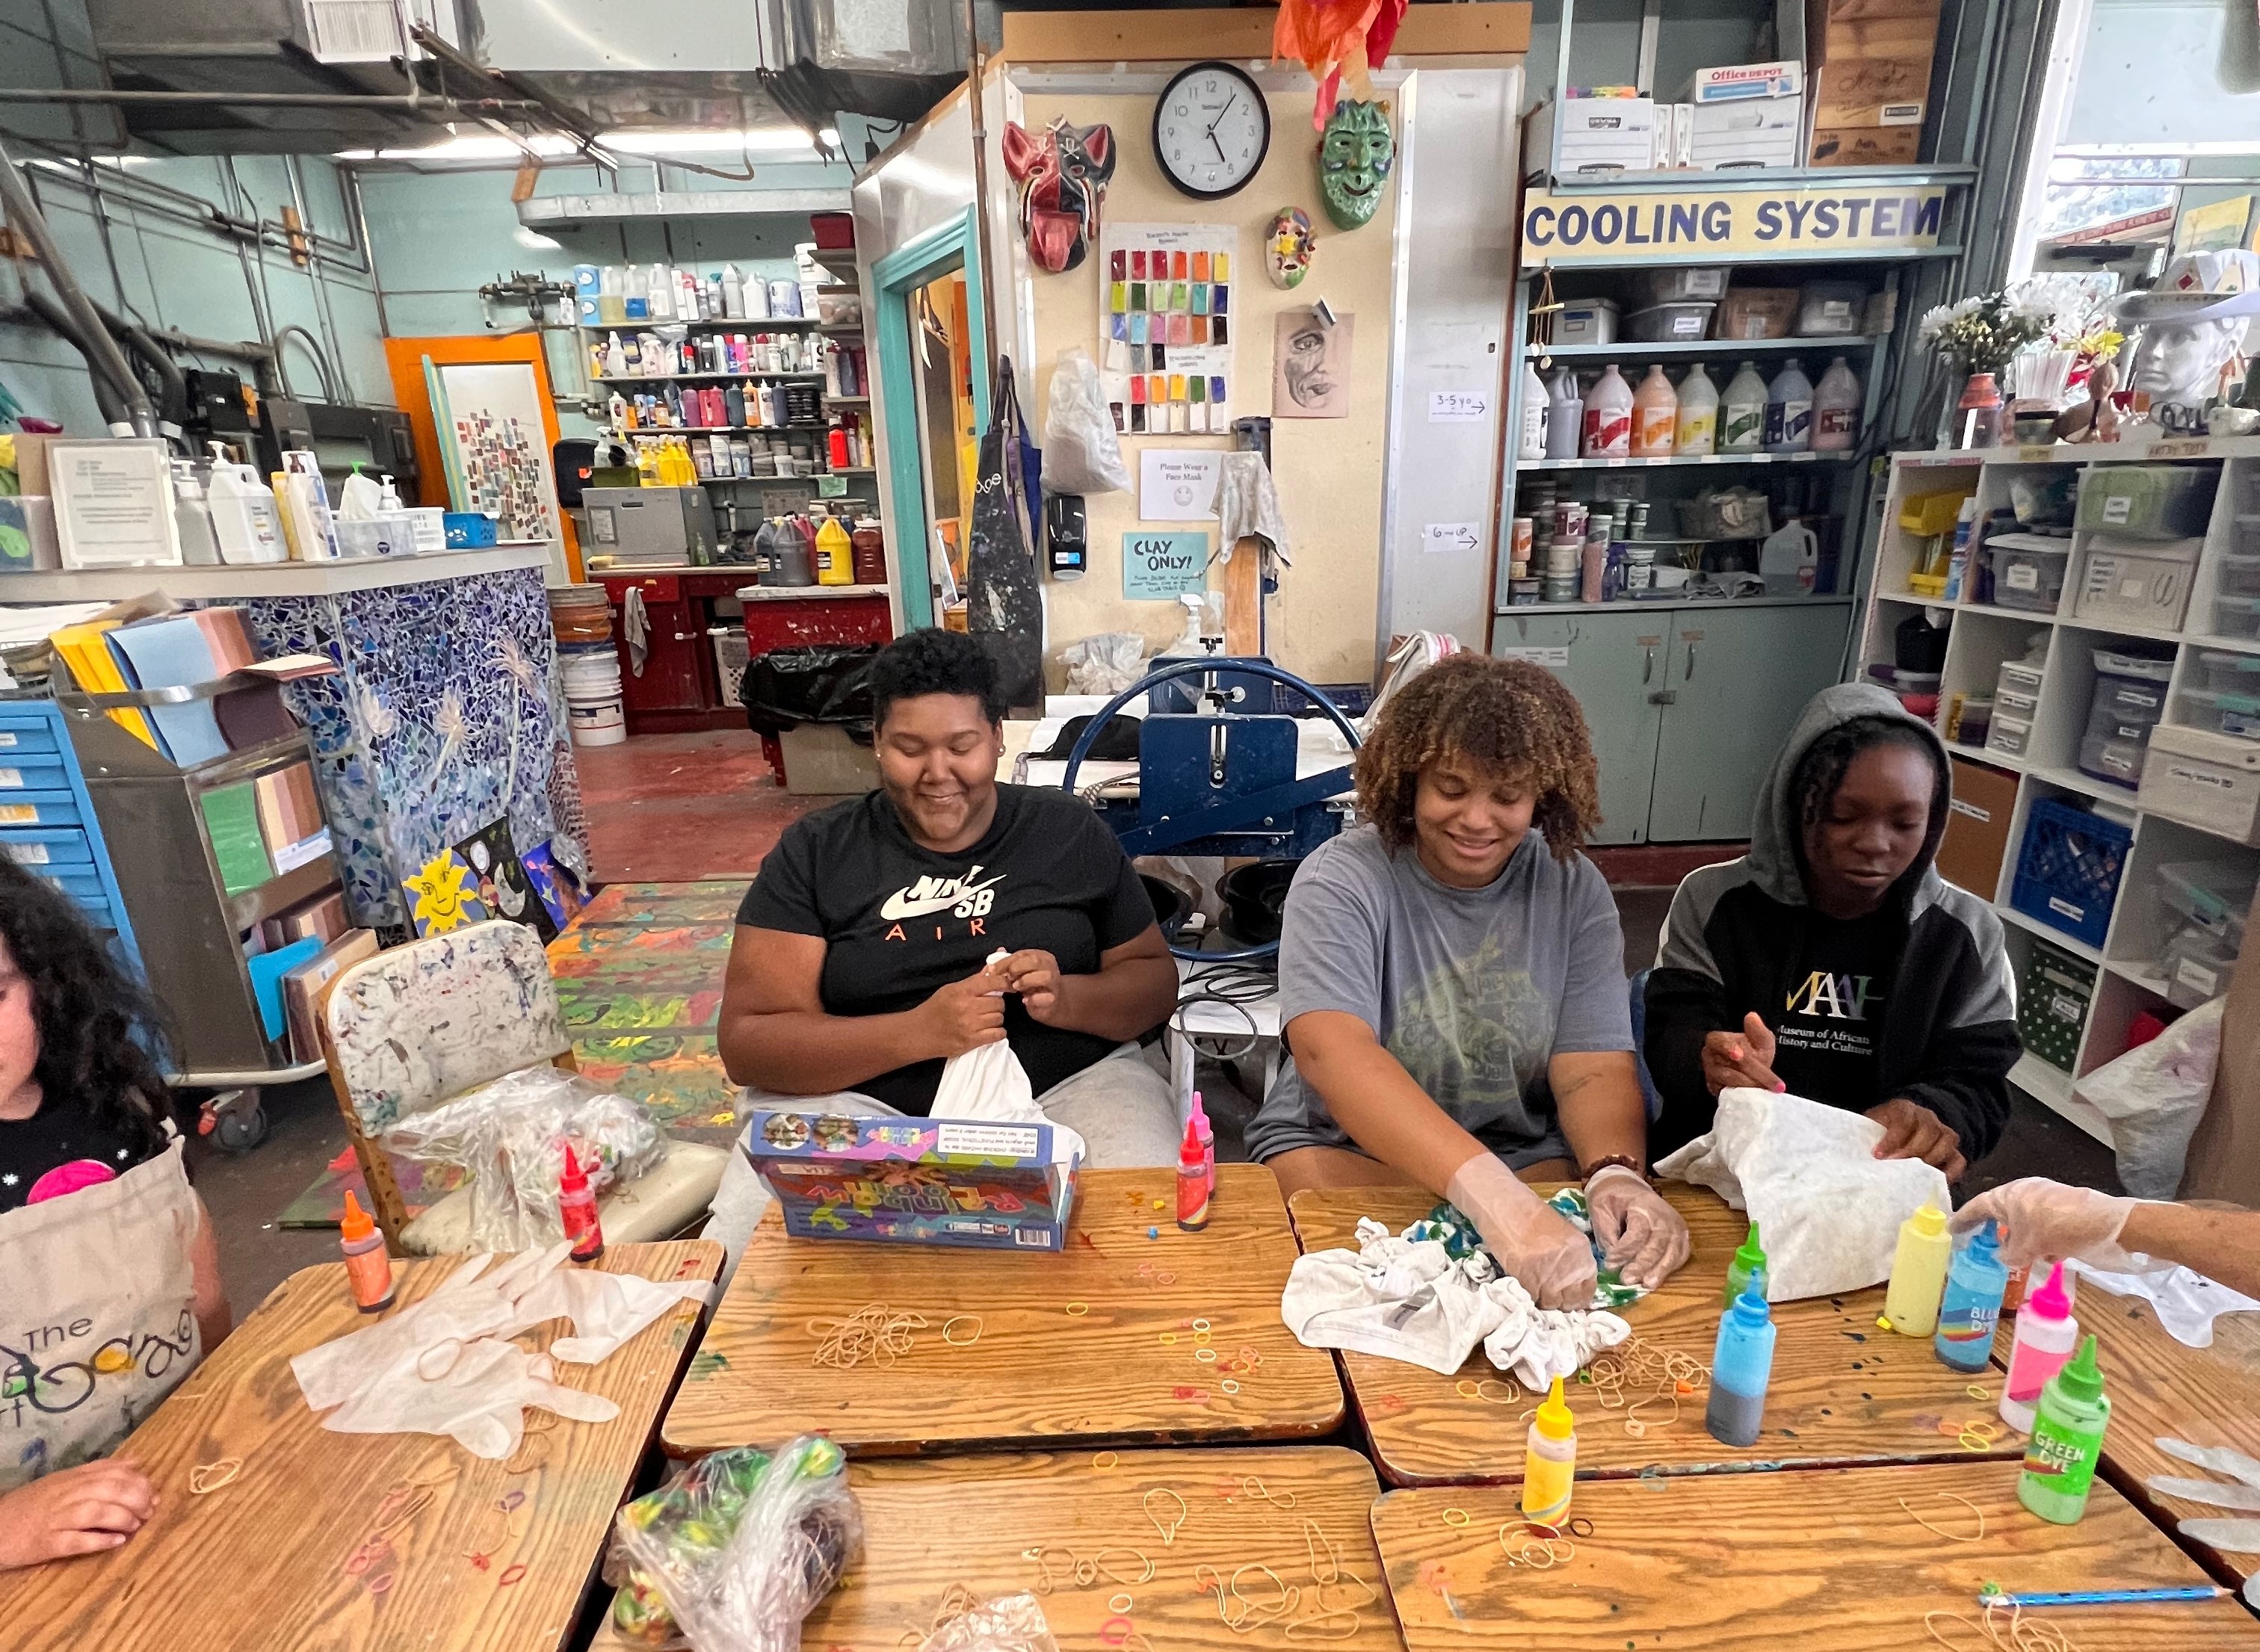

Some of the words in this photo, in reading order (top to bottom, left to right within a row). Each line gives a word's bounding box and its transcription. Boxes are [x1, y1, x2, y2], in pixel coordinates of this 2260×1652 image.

[1711, 70, 1747, 81] Office
[1749, 68, 1782, 78] DEPOT
[1205, 80, 1217, 93] 12
[1174, 105, 1188, 117] 10
[1242, 103, 1249, 117] 2
[1167, 126, 1175, 138] 9
[1248, 124, 1256, 137] 3
[1174, 149, 1181, 161] 8
[1241, 147, 1248, 158] 4
[1227, 163, 1235, 176] 5
[1526, 202, 1732, 246] COOLING
[1754, 196, 1942, 241] SYSTEM
[1437, 395, 1456, 405] 3-5
[1160, 463, 1182, 471] Please
[1183, 463, 1202, 471] Wear
[1183, 472, 1202, 480] Mask
[1433, 527, 1442, 538] 6
[1134, 539, 1172, 556] CLAY
[1147, 555, 1192, 571] ONLY!
[954, 888, 995, 918] SB
[1817, 1030, 1829, 1039] of
[1830, 1030, 1870, 1045] African
[1810, 1040, 1830, 1049] and
[1831, 1042, 1873, 1056] Culture
[22, 1318, 93, 1352] The
[2035, 1430, 2086, 1461] GREEN
[2038, 1450, 2069, 1473] DYE
